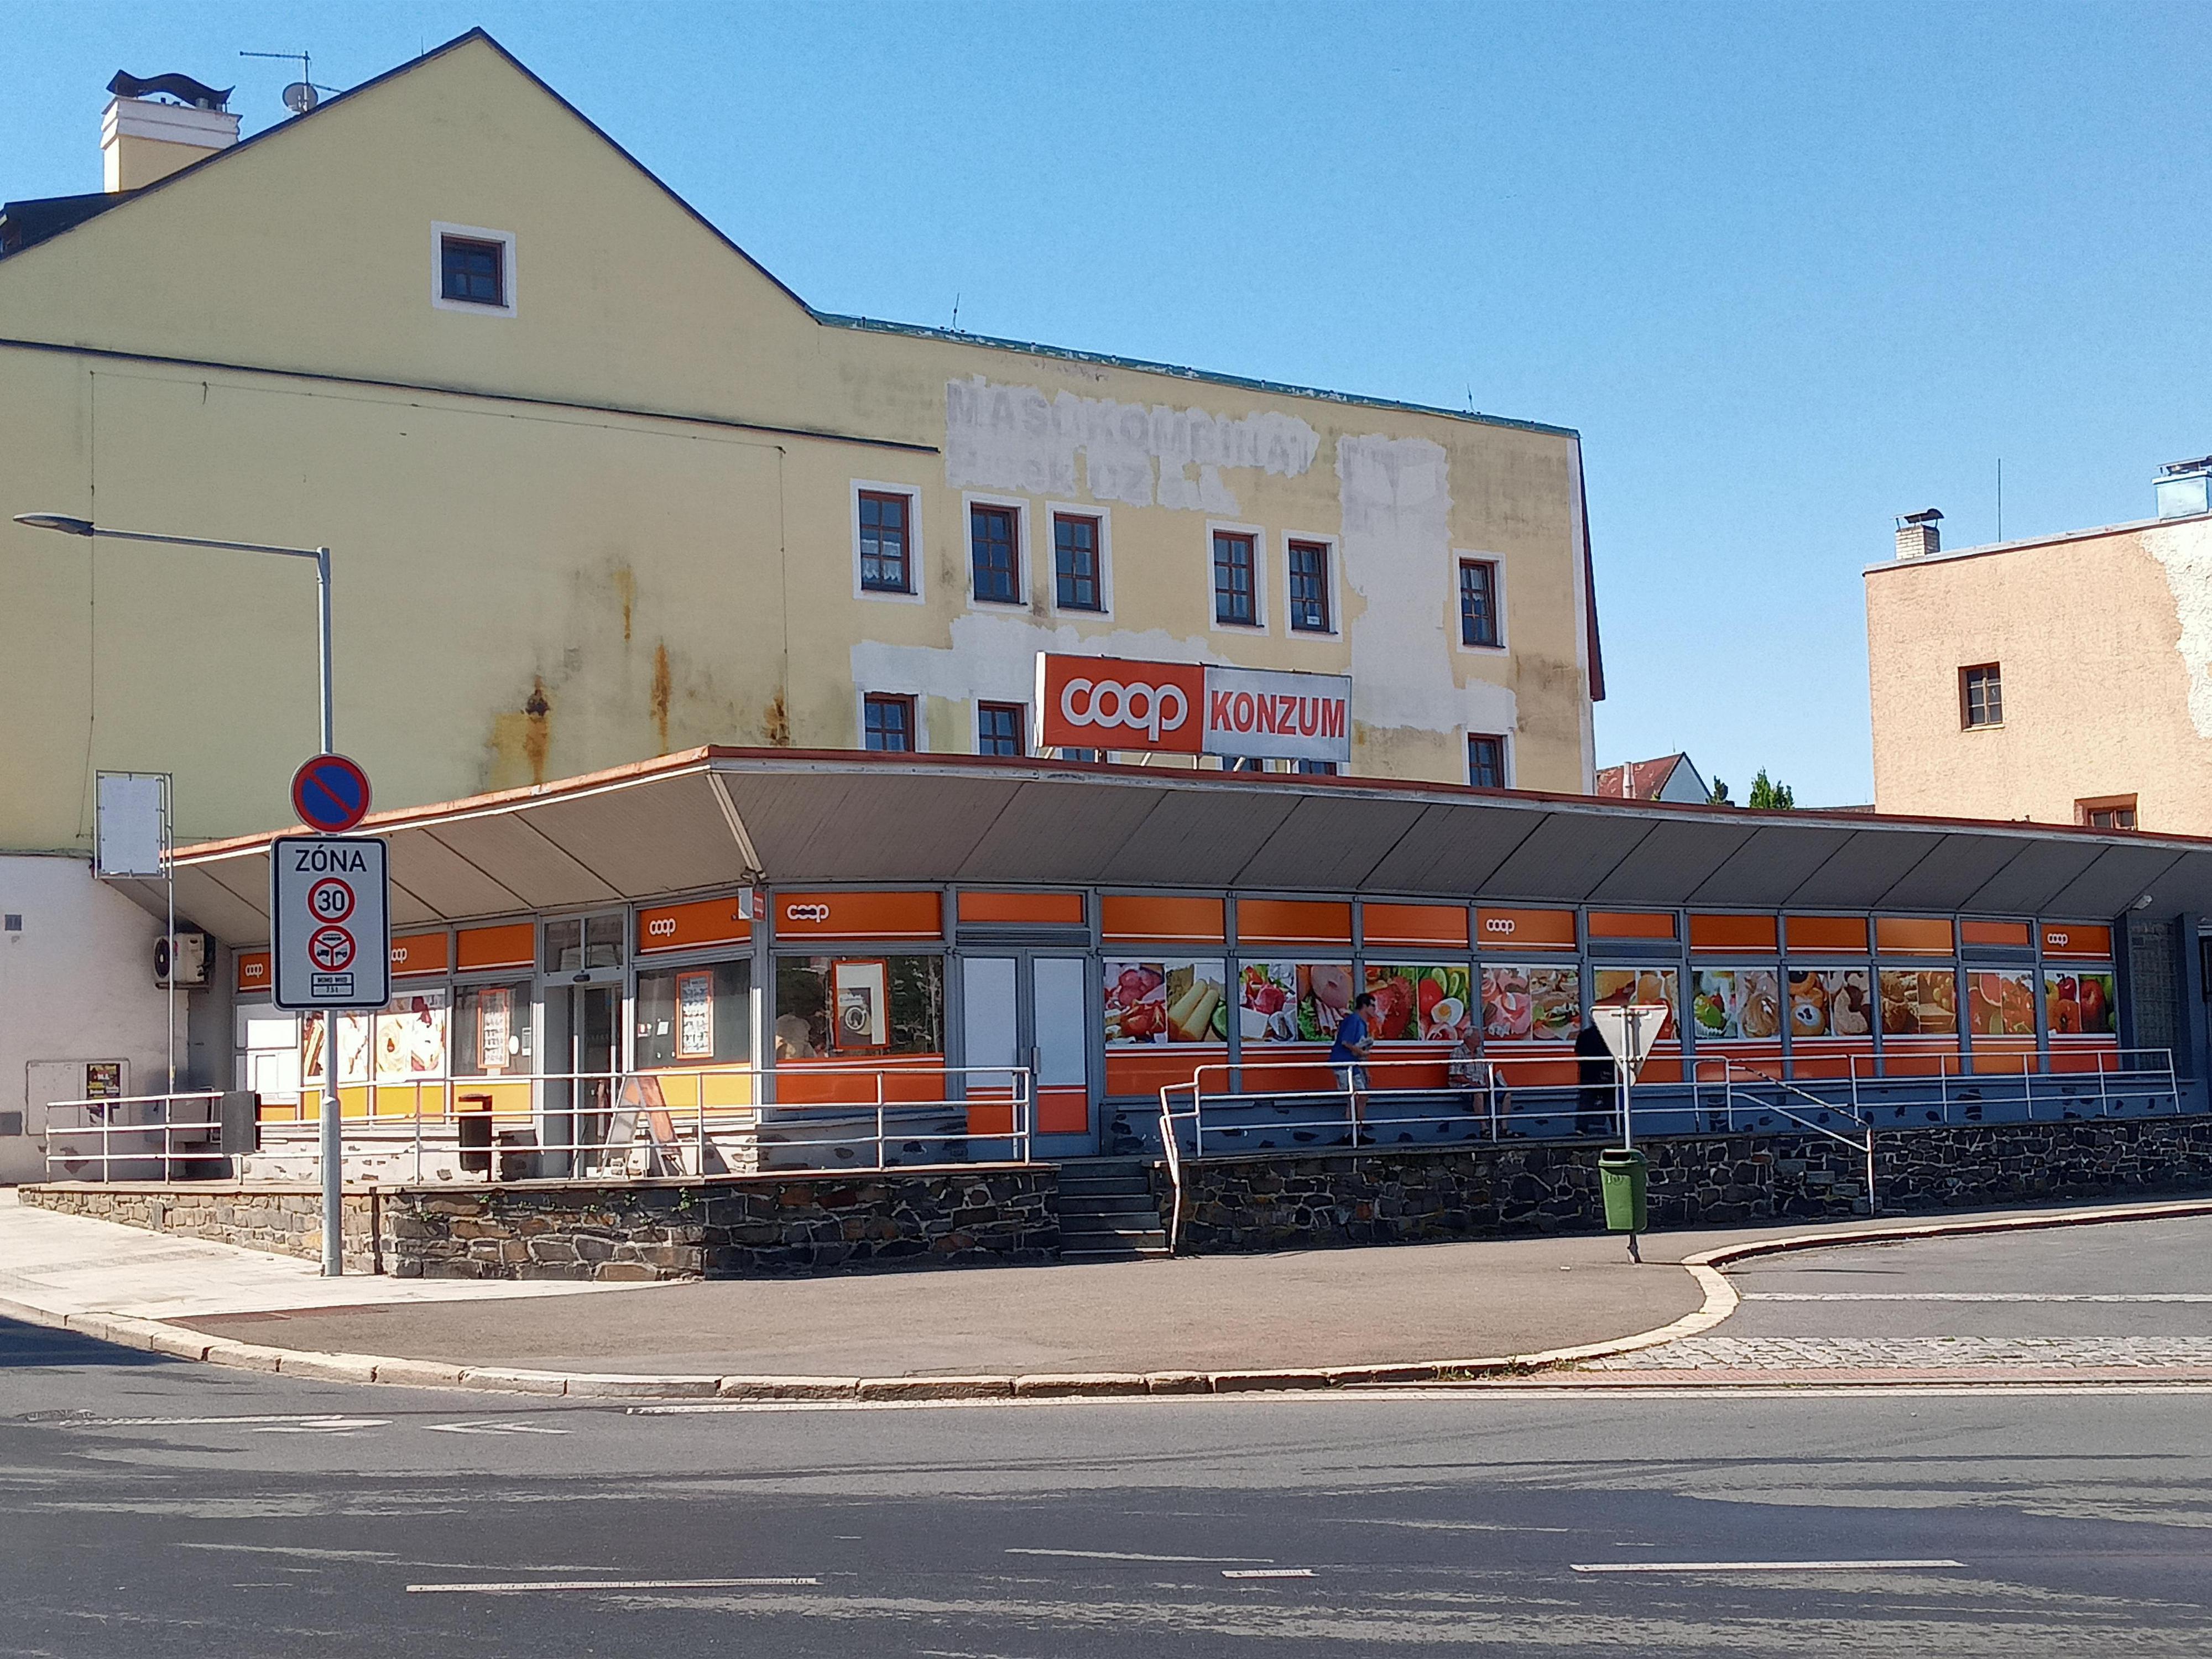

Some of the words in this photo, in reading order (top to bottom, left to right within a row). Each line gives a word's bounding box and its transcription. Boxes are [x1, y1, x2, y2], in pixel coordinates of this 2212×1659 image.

[1061, 677, 1188, 742] coop
[1211, 690, 1345, 738] KONZUM
[295, 845, 367, 872] ZÓNA
[317, 890, 345, 911] 30
[787, 905, 829, 922] coop
[650, 919, 676, 937] coop
[1486, 919, 1515, 935] coop
[2047, 933, 2067, 946] coop
[391, 948, 408, 964] oop
[246, 963, 263, 978] coop
